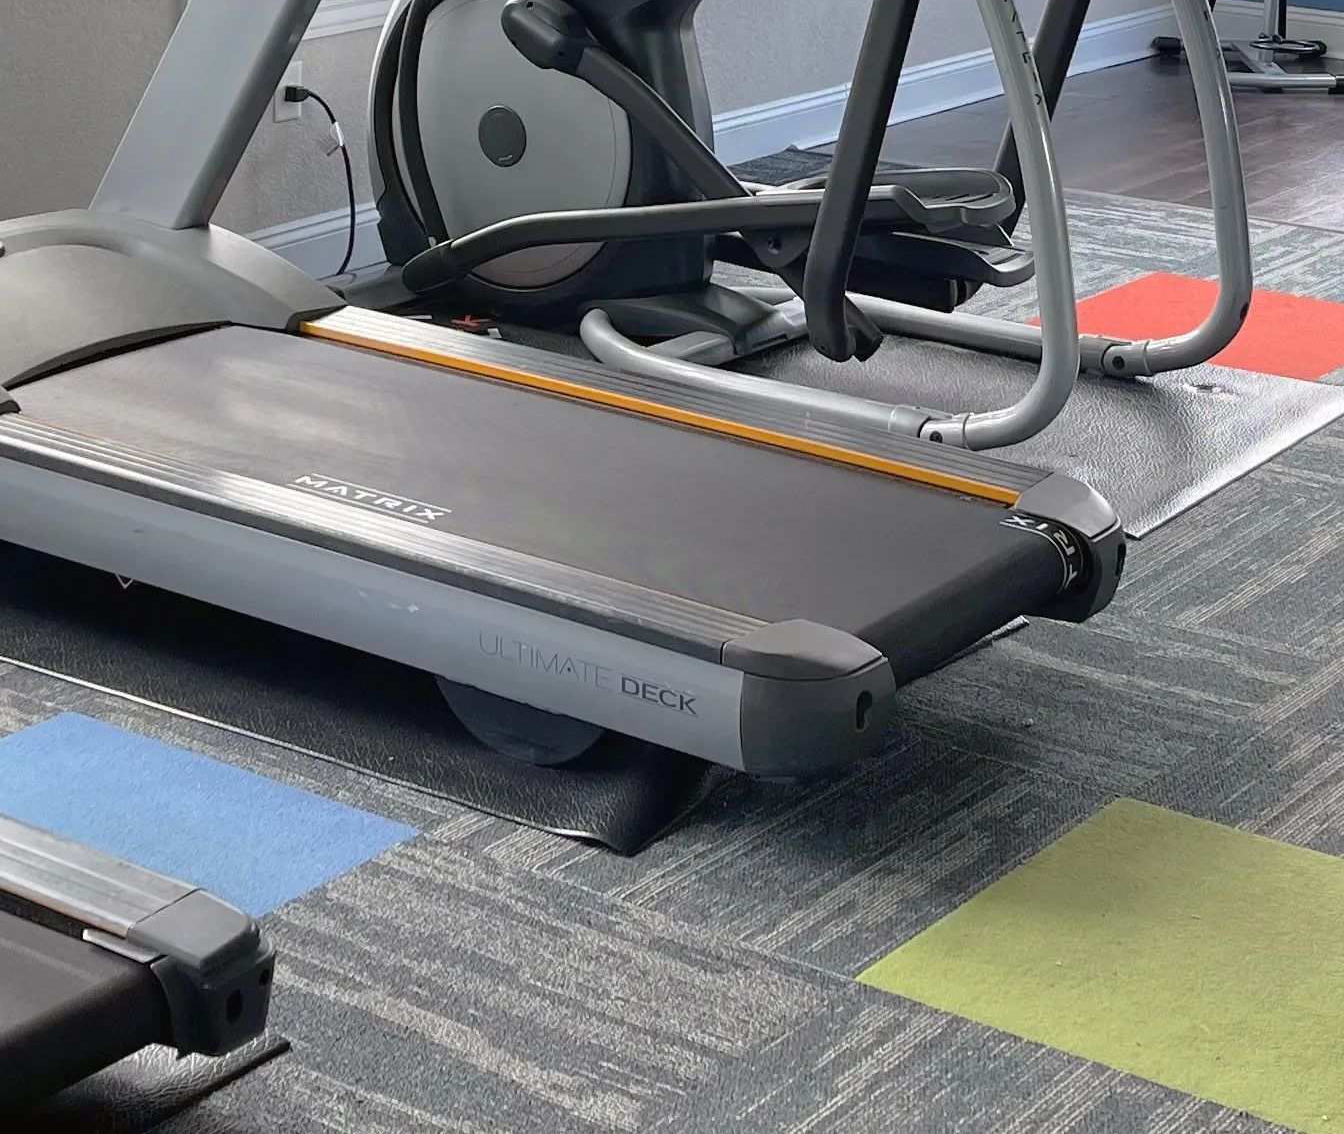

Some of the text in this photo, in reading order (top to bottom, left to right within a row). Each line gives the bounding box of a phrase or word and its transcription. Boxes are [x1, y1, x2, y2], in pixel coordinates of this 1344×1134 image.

[294, 475, 446, 521] MATRIX
[478, 629, 698, 716] ULTIMATE DECK
